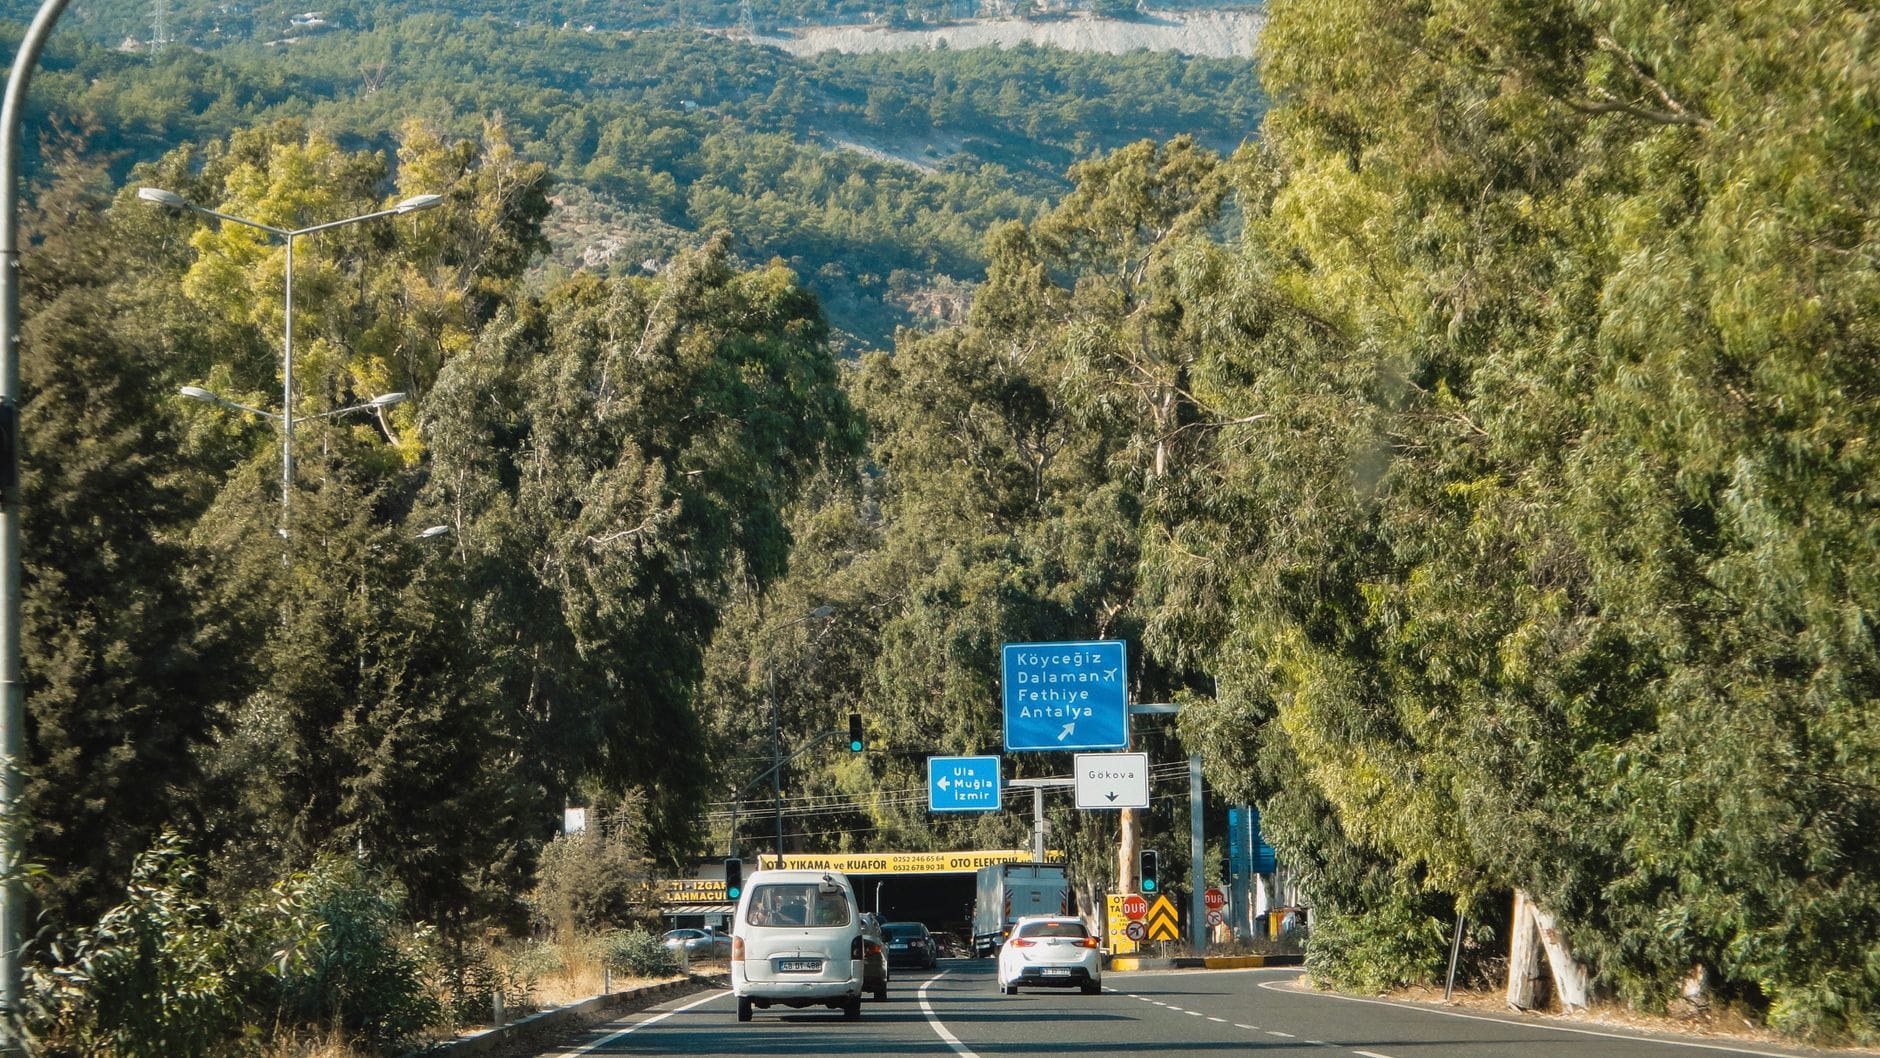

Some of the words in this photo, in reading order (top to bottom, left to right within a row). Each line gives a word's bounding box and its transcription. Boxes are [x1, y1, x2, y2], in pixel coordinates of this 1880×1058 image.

[1017, 652, 1101, 668] Köyceğiz
[1018, 671, 1099, 683] Dalaman
[1018, 688, 1089, 703] Fethiye
[1020, 704, 1093, 720] Antalya
[954, 767, 974, 776] Ula
[1088, 770, 1134, 779] Gökova
[954, 779, 993, 790] Muğla
[954, 789, 990, 800] İzmir
[790, 860, 831, 870] YIKAMA
[950, 858, 971, 868] OTO
[667, 892, 727, 901] LAHMACU
[1205, 895, 1223, 903] DUR
[1124, 903, 1146, 914] DUR
